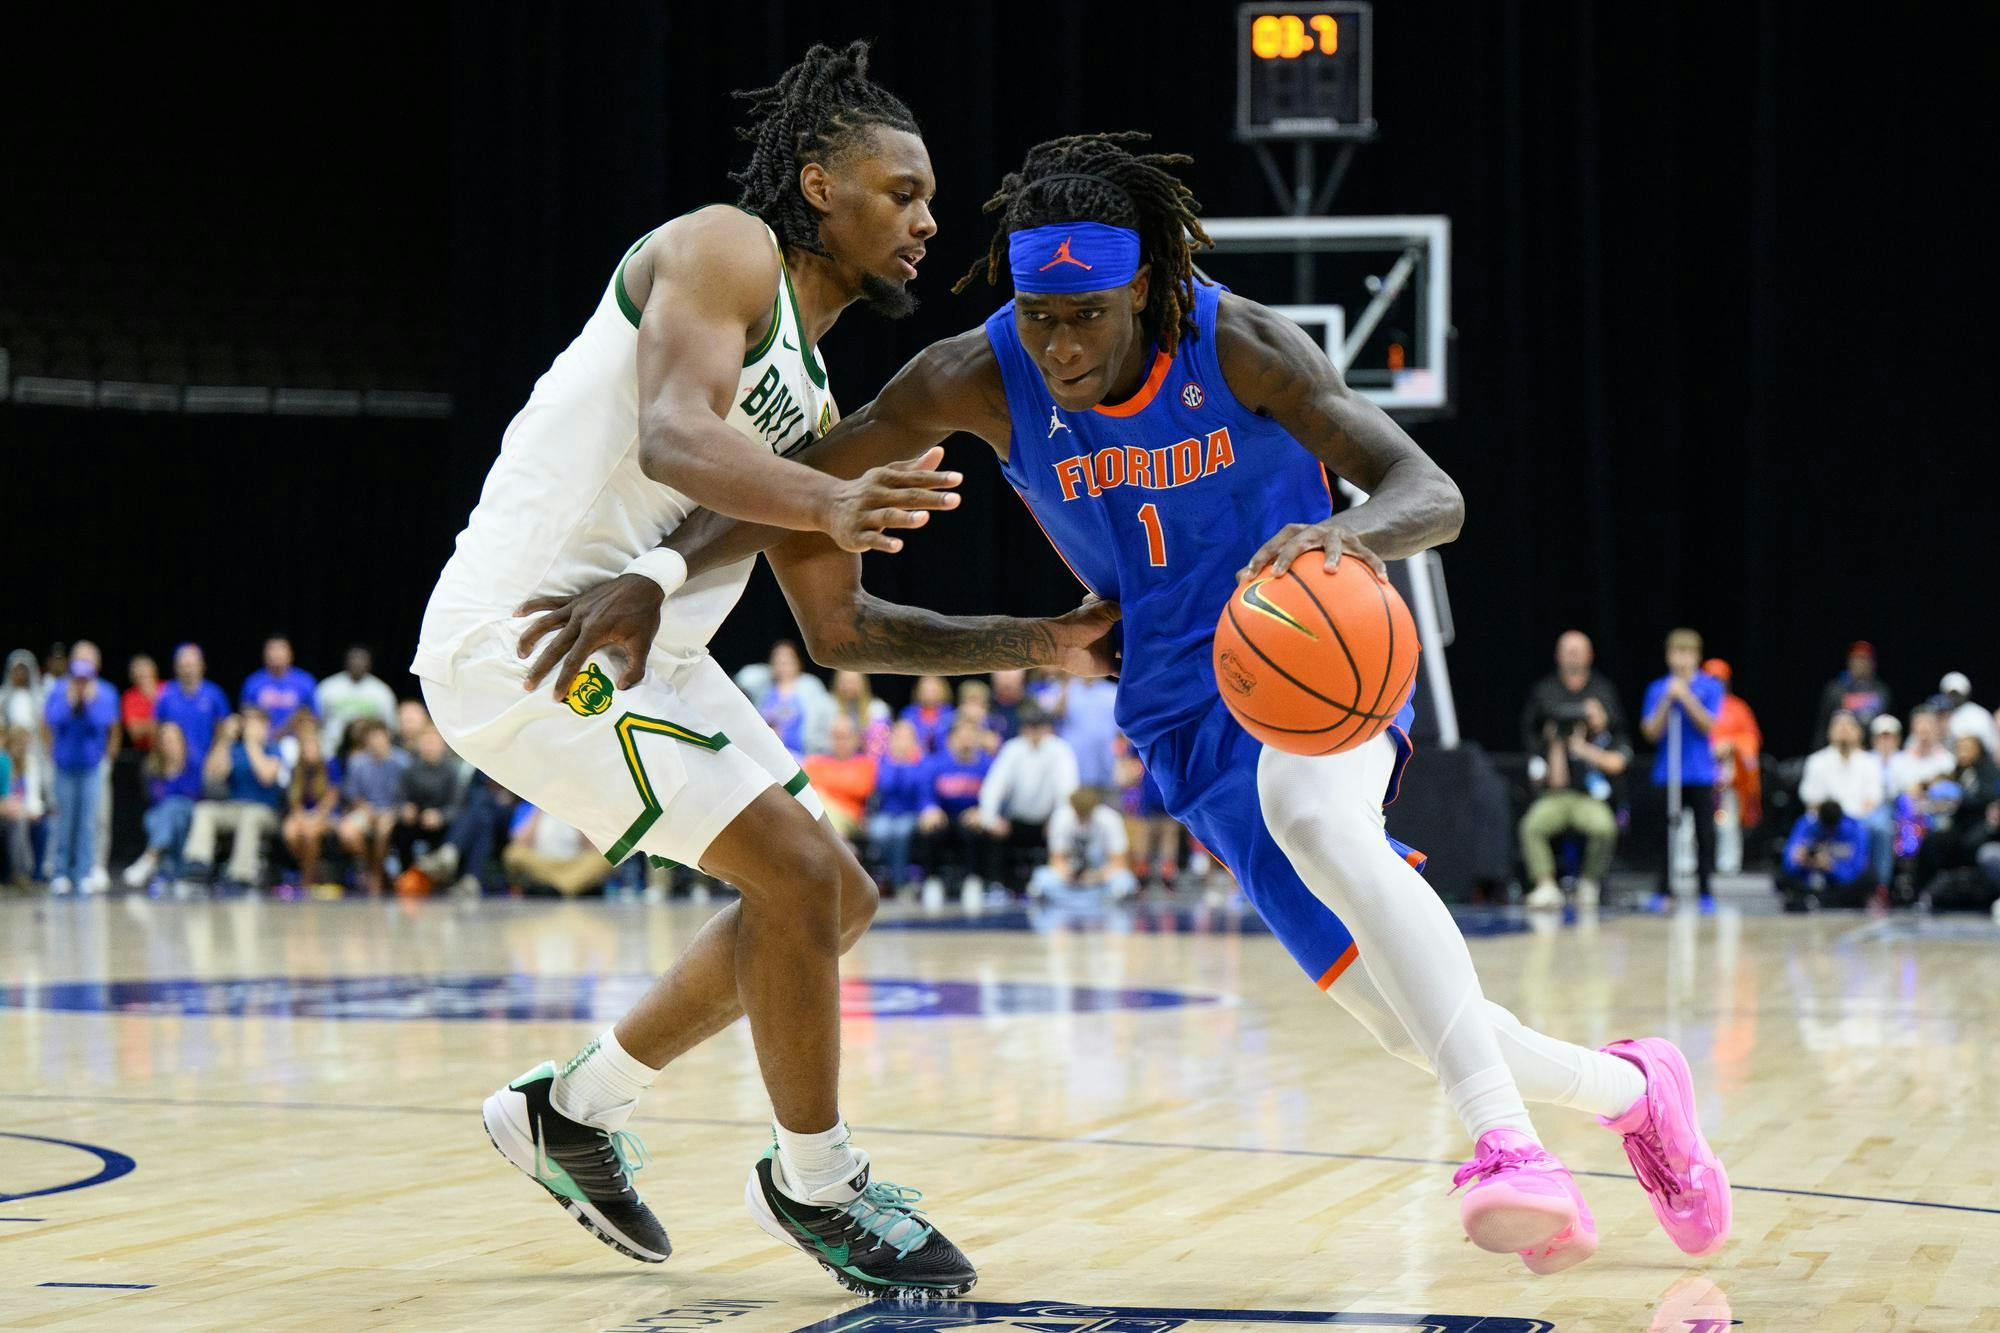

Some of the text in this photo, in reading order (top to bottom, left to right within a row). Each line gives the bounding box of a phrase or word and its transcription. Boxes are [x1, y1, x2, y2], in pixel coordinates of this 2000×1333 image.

[740, 363, 814, 459] BAYLO
[1182, 384, 1203, 407] SEC
[1052, 426, 1236, 502] FLORIDA
[1137, 503, 1168, 567] 1
